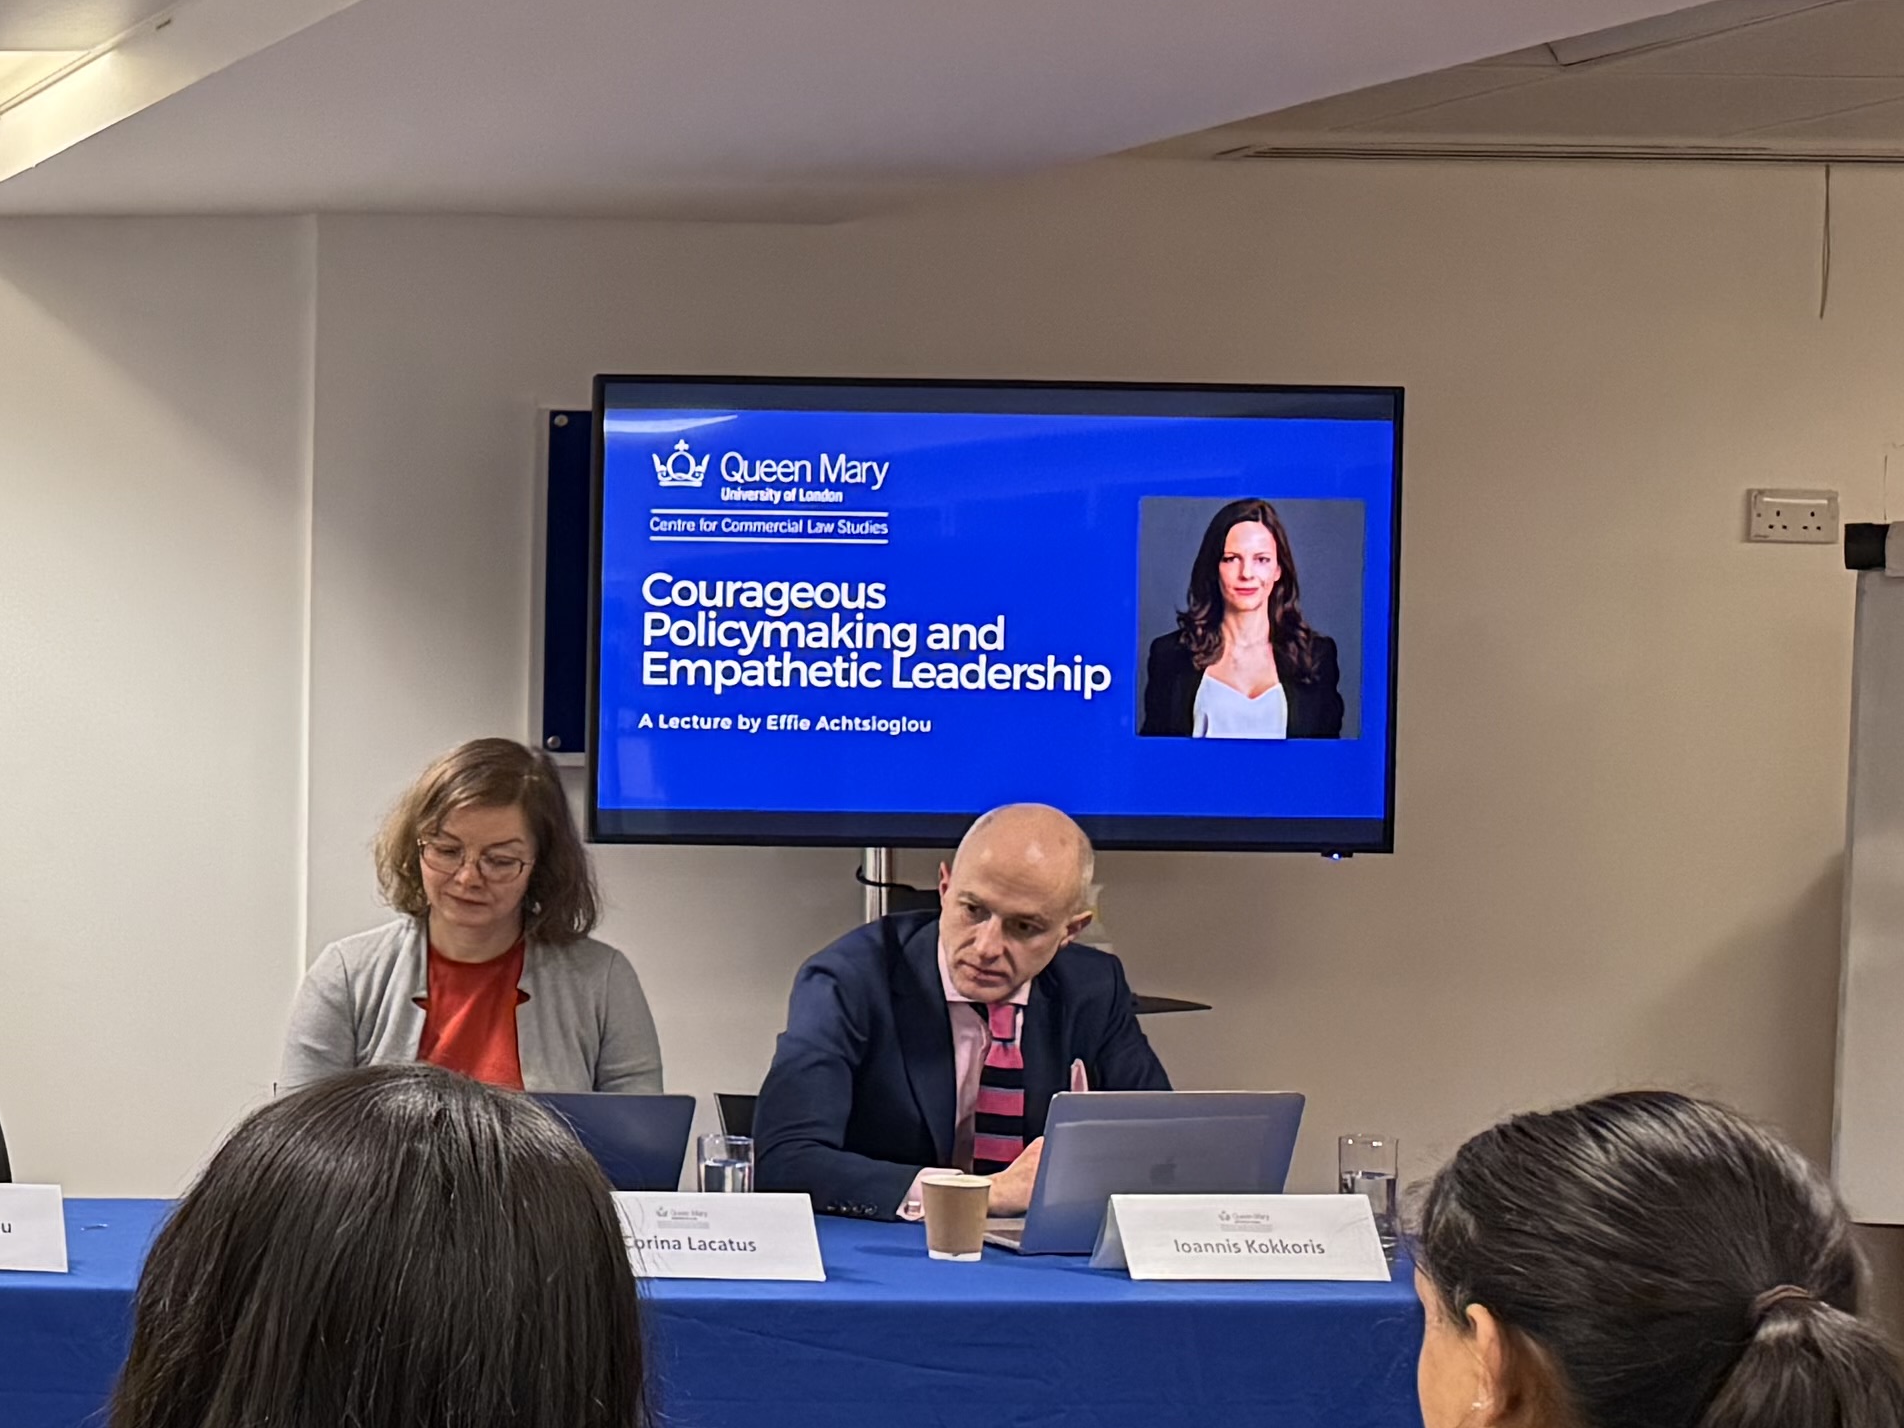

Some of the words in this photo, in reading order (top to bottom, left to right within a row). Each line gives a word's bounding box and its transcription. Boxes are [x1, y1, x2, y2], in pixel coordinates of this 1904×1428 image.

[720, 451, 812, 484] Queen
[820, 453, 890, 490] Mary
[720, 486, 782, 504] University
[783, 488, 796, 502] of
[799, 488, 843, 503] London
[650, 517, 695, 532] Centre
[699, 518, 718, 532] for
[721, 518, 803, 534] Commercial
[807, 519, 835, 534] Law
[837, 519, 888, 535] Studies
[642, 572, 886, 617] Courageous
[643, 611, 918, 659] Policymaking
[926, 614, 1006, 651] and
[642, 650, 882, 695] Empathetic
[892, 650, 1112, 700] Leadership
[638, 713, 653, 729] A
[658, 713, 732, 730] Lecture
[737, 713, 762, 733] by
[766, 713, 811, 731] Effie
[815, 715, 932, 735] Achtsioglou
[688, 1237, 757, 1253] Lacatus
[1174, 1239, 1242, 1254] Ioannis
[1245, 1239, 1325, 1254] Kokkoris
